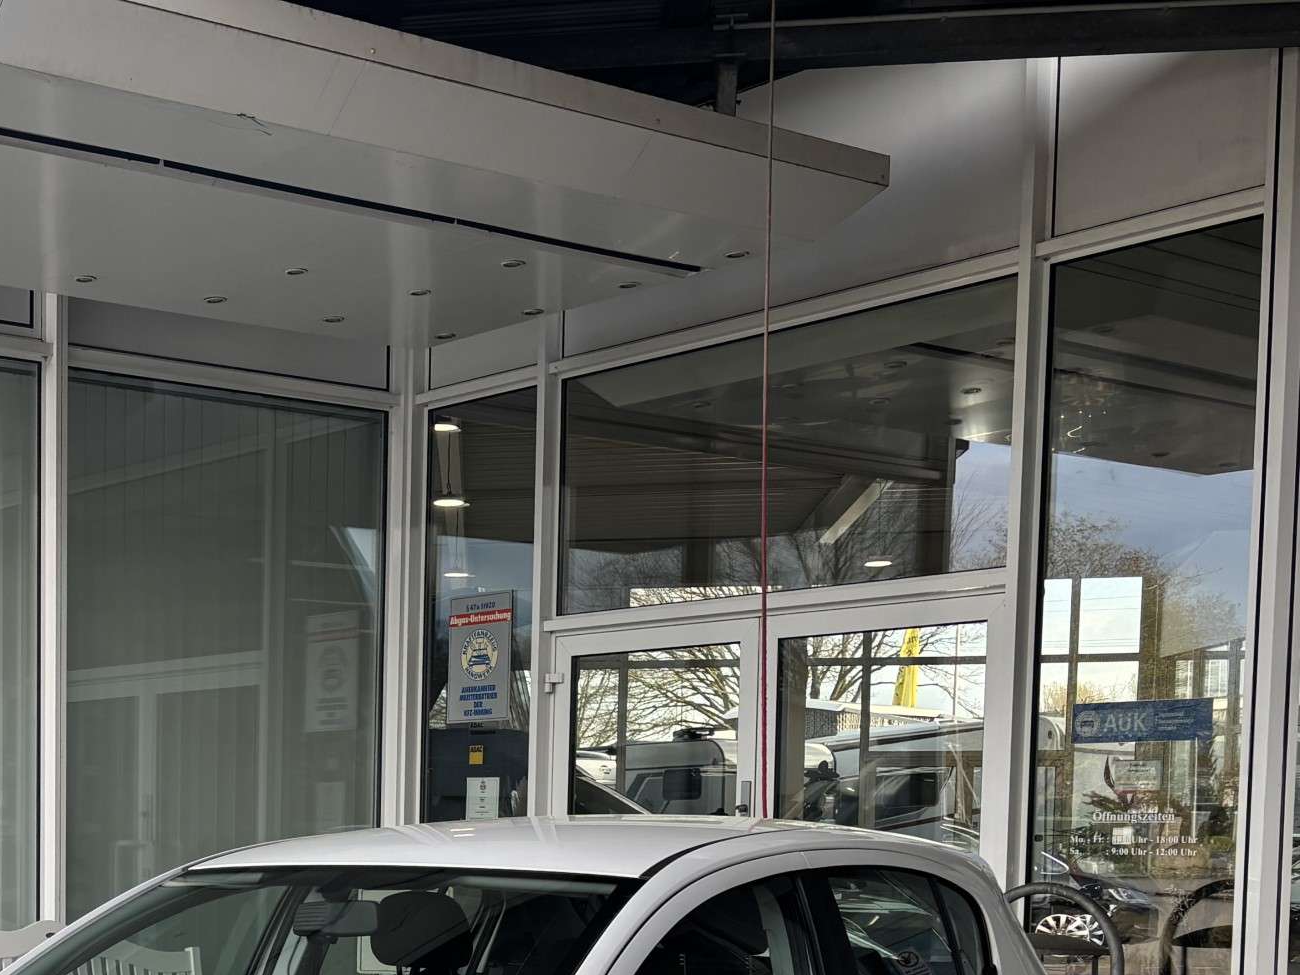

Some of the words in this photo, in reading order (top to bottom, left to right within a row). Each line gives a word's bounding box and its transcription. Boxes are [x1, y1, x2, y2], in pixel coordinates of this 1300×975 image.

[450, 610, 511, 626] Abgas-Untersuchung
[1092, 810, 1175, 823] Öffnungszeiten
[1156, 835, 1179, 844] 18:00
[1181, 835, 1198, 844] Uhr
[1131, 847, 1148, 856] Uhr
[1156, 847, 1178, 856] 12:00
[1180, 847, 1197, 856] Uhr
